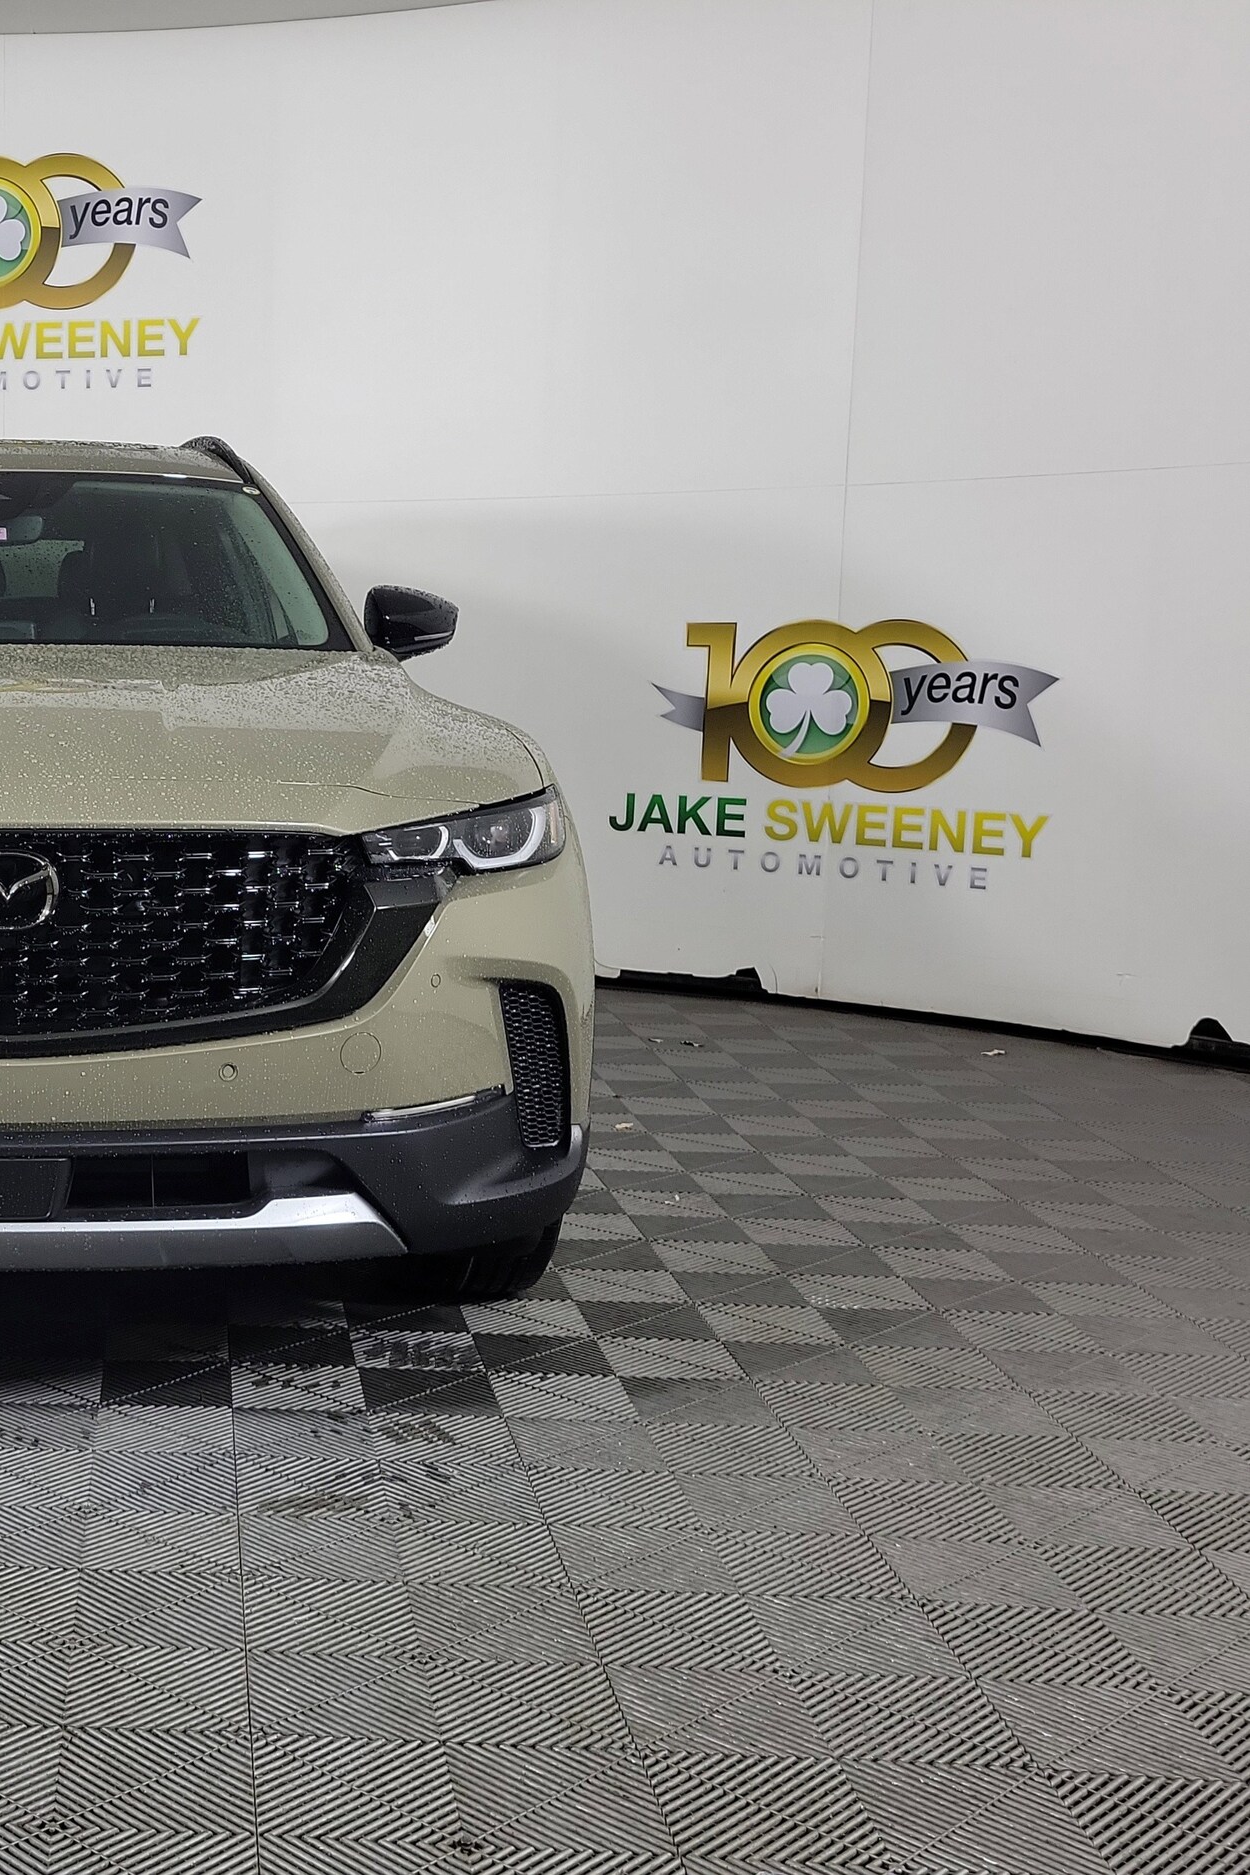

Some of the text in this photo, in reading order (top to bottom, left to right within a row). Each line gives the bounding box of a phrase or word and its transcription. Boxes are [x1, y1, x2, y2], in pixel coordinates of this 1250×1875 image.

[69, 193, 170, 240] years
[685, 618, 1020, 793] 100 years
[608, 793, 1050, 858] JAKE SWEENEY
[658, 845, 989, 891] AUTOMOTIVE
